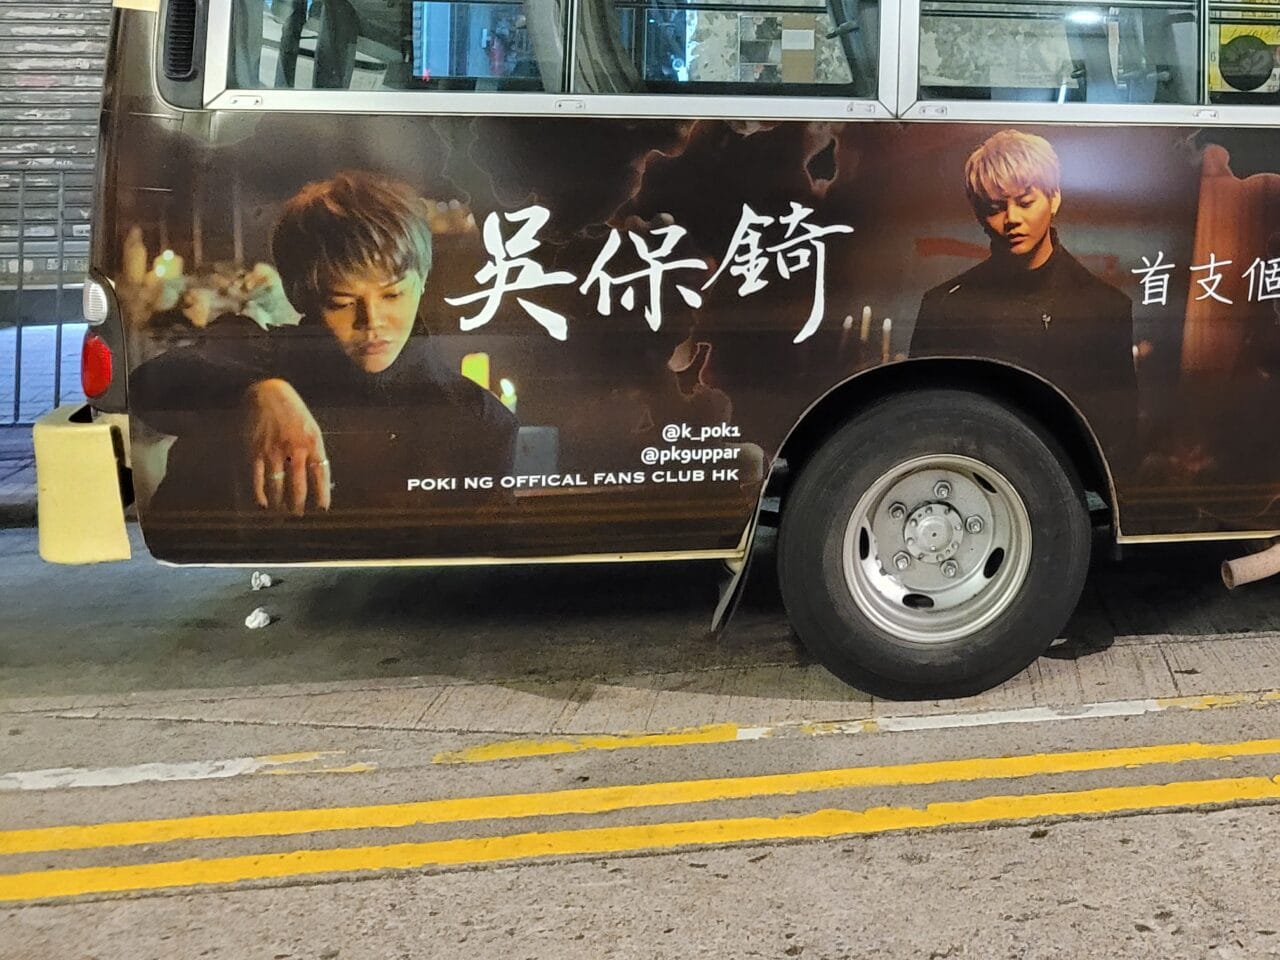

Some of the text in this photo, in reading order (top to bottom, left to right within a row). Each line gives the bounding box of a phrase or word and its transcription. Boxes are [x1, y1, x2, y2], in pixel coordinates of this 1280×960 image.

[407, 468, 740, 492] POKI NG OFFICAL FANS CLUB HK
